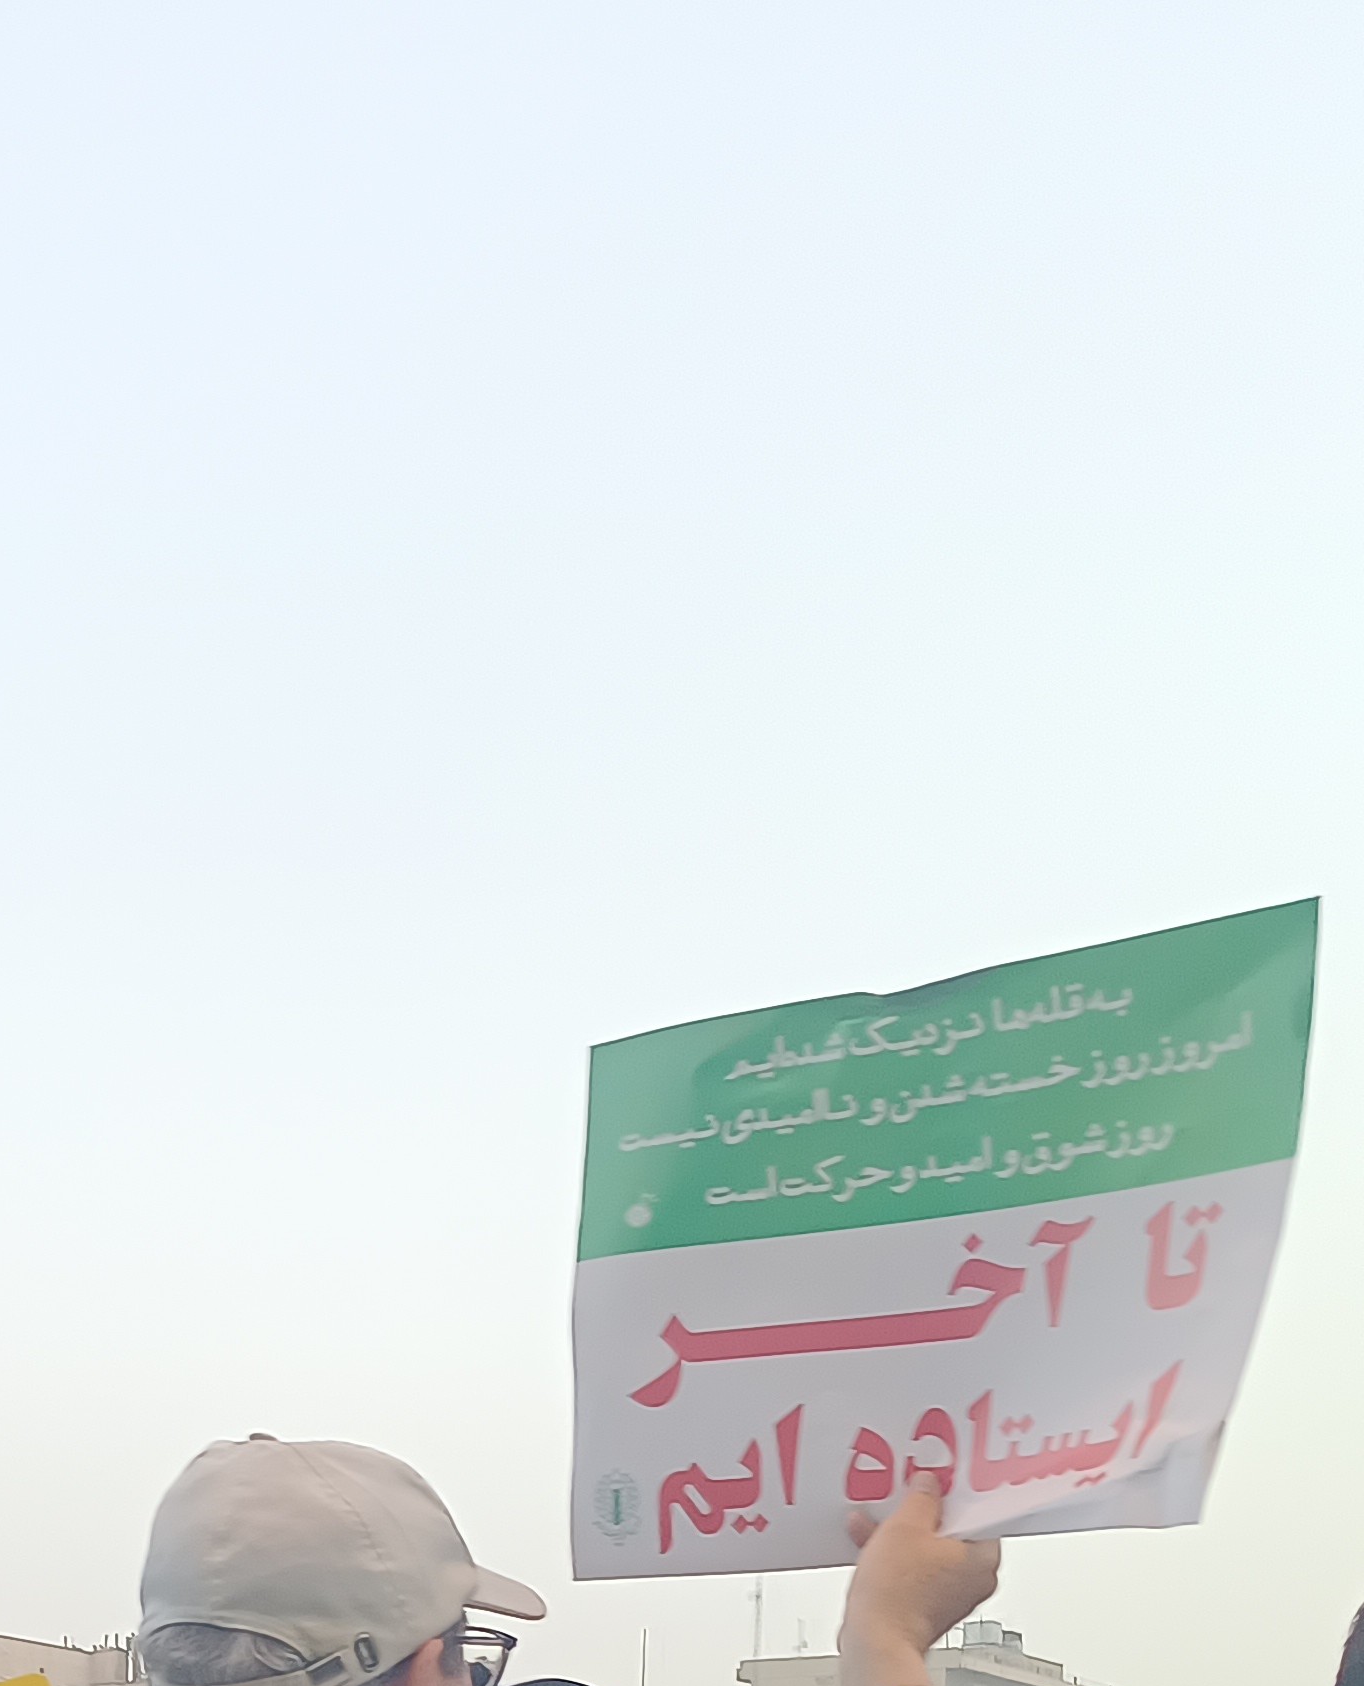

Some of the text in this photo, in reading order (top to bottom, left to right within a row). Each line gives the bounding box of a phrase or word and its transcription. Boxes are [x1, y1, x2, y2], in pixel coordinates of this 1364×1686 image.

[849, 1013, 984, 1056] نزدیک
[1151, 1010, 1254, 1076] امروز
[969, 1054, 1081, 1097] خسته
[1080, 1049, 1151, 1088] روز
[859, 1097, 887, 1126] و
[890, 1074, 967, 1124] شدن
[618, 1113, 721, 1151] نیست
[705, 1120, 1175, 1205] روز شوق و امید و حرکت است
[629, 1201, 1223, 1408] تا آخر
[659, 1360, 1182, 1554] ایستاده ایم
